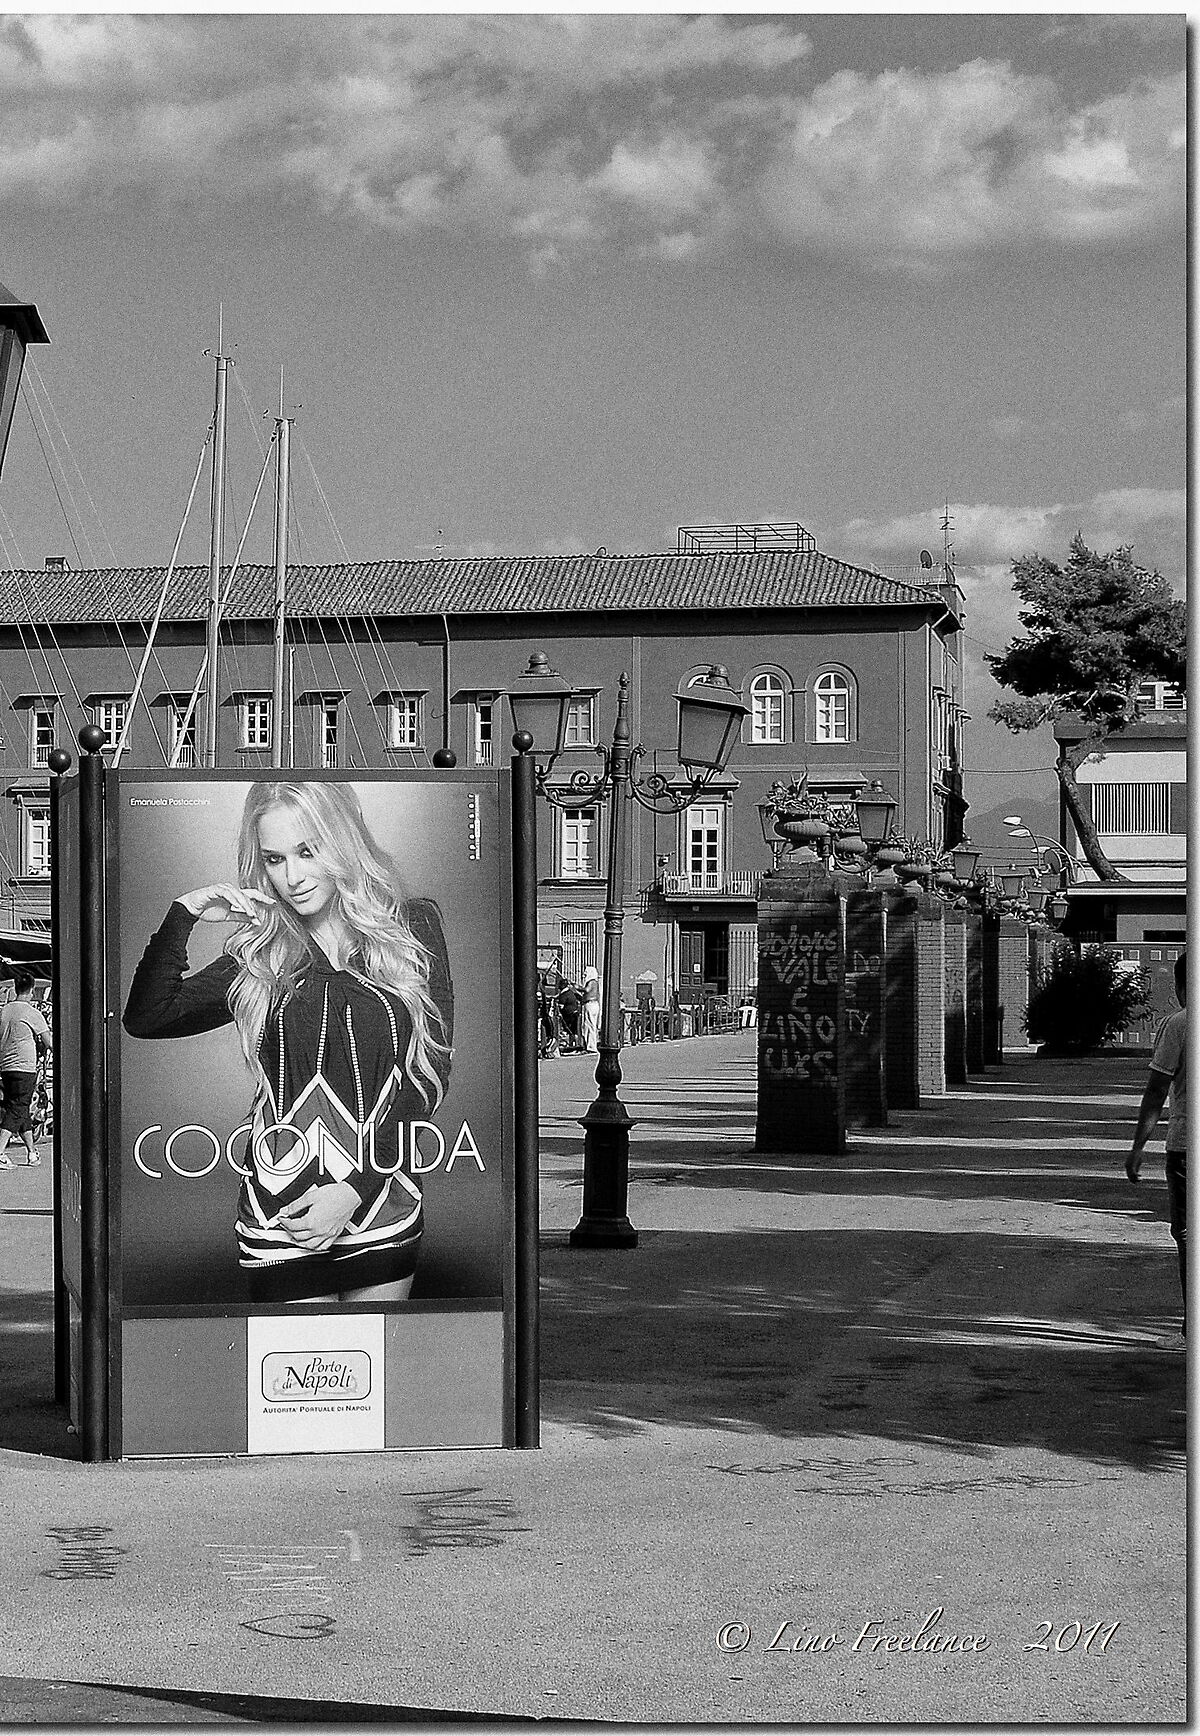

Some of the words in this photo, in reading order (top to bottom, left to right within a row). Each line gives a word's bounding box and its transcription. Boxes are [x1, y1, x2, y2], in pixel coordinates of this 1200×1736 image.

[130, 797, 168, 806] Emanuela
[133, 1120, 487, 1179] COCONUDA
[311, 1357, 342, 1373] Porto
[282, 1377, 293, 1389] di
[285, 1364, 353, 1395] Napoli
